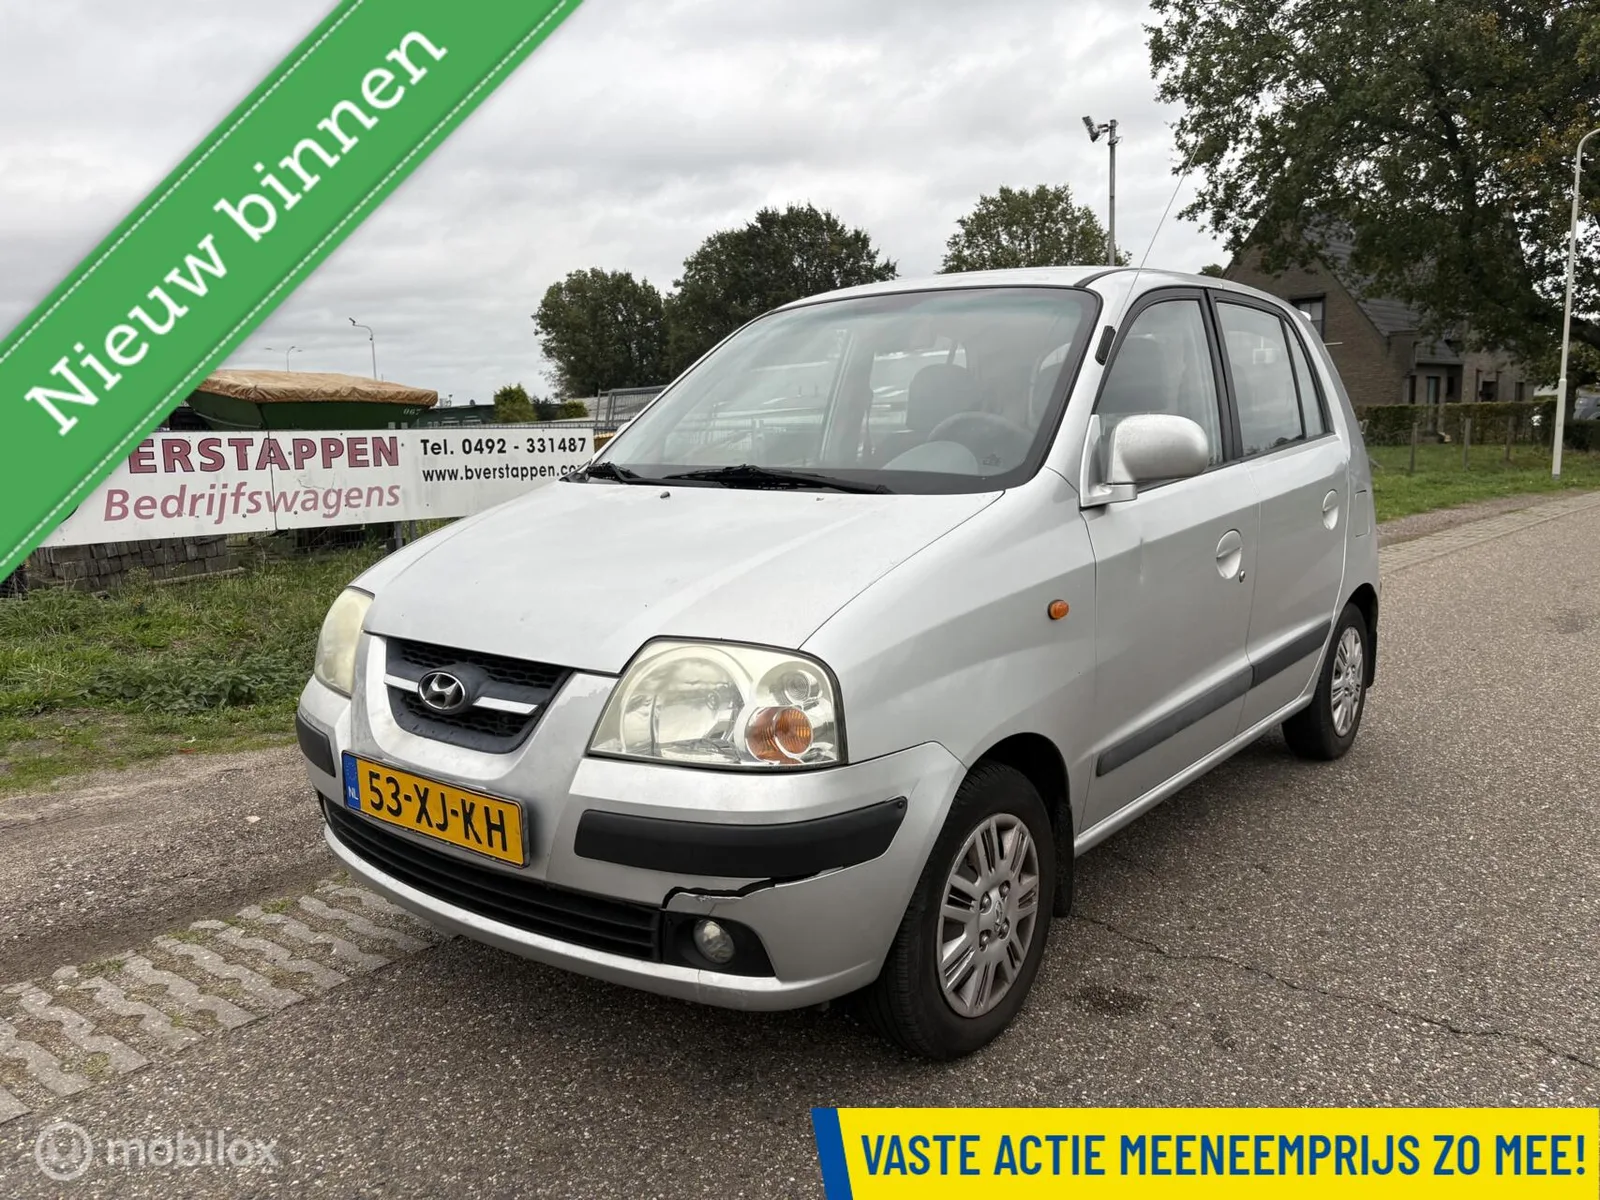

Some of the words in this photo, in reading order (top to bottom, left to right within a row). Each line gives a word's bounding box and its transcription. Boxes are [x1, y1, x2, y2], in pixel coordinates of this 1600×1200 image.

[420, 438, 454, 456] Tel.
[461, 437, 507, 455] 0492
[526, 436, 587, 454] 331487
[422, 463, 581, 482] www.bverstappen.co
[104, 481, 401, 525] Bedrijfswagens
[347, 785, 360, 801] NL
[368, 769, 508, 852] 53-XJ-KH
